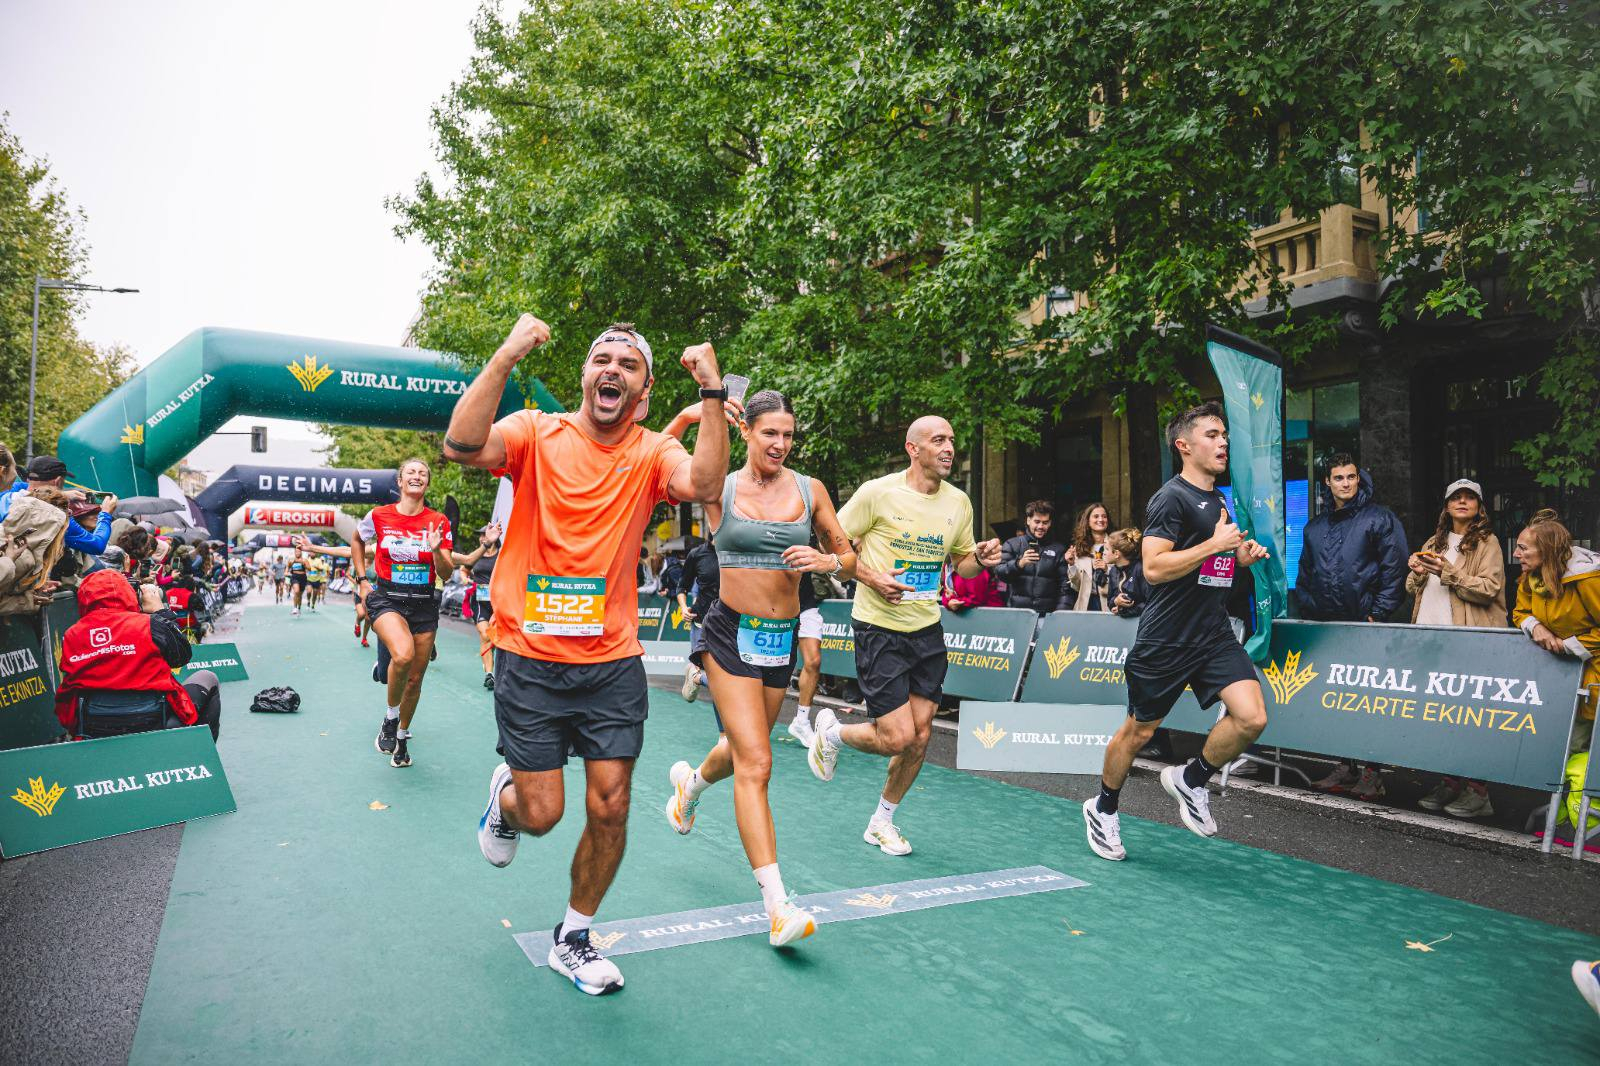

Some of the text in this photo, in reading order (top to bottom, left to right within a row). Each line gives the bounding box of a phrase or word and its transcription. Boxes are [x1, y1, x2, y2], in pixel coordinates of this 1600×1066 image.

[340, 370, 469, 395] RURAL KUTXA
[146, 373, 215, 428] RURAL KUTXA
[258, 475, 372, 494] DECIMAS
[272, 511, 326, 524] EROSKI
[1213, 556, 1232, 571] 612
[398, 571, 423, 582] 404
[904, 572, 931, 585] 613
[535, 593, 594, 614] 1522
[753, 632, 784, 648] 611
[943, 633, 1015, 654] RAL KUTXA
[0, 648, 39, 677] KUTXA
[187, 658, 239, 670] RURAL KUTXA
[964, 654, 1009, 672] EKINTZA
[1084, 645, 1129, 665] RURA
[7, 676, 47, 704] EKINTZA
[1326, 663, 1543, 706] RURAL KUTXA
[1321, 691, 1537, 734] GIZARTE EKINTZA
[1012, 732, 1061, 745] RURAL
[74, 764, 212, 800] RURAL KUTXA
[908, 875, 1064, 898] RURAL KUTXA
[638, 905, 831, 938] RURAL KUA
